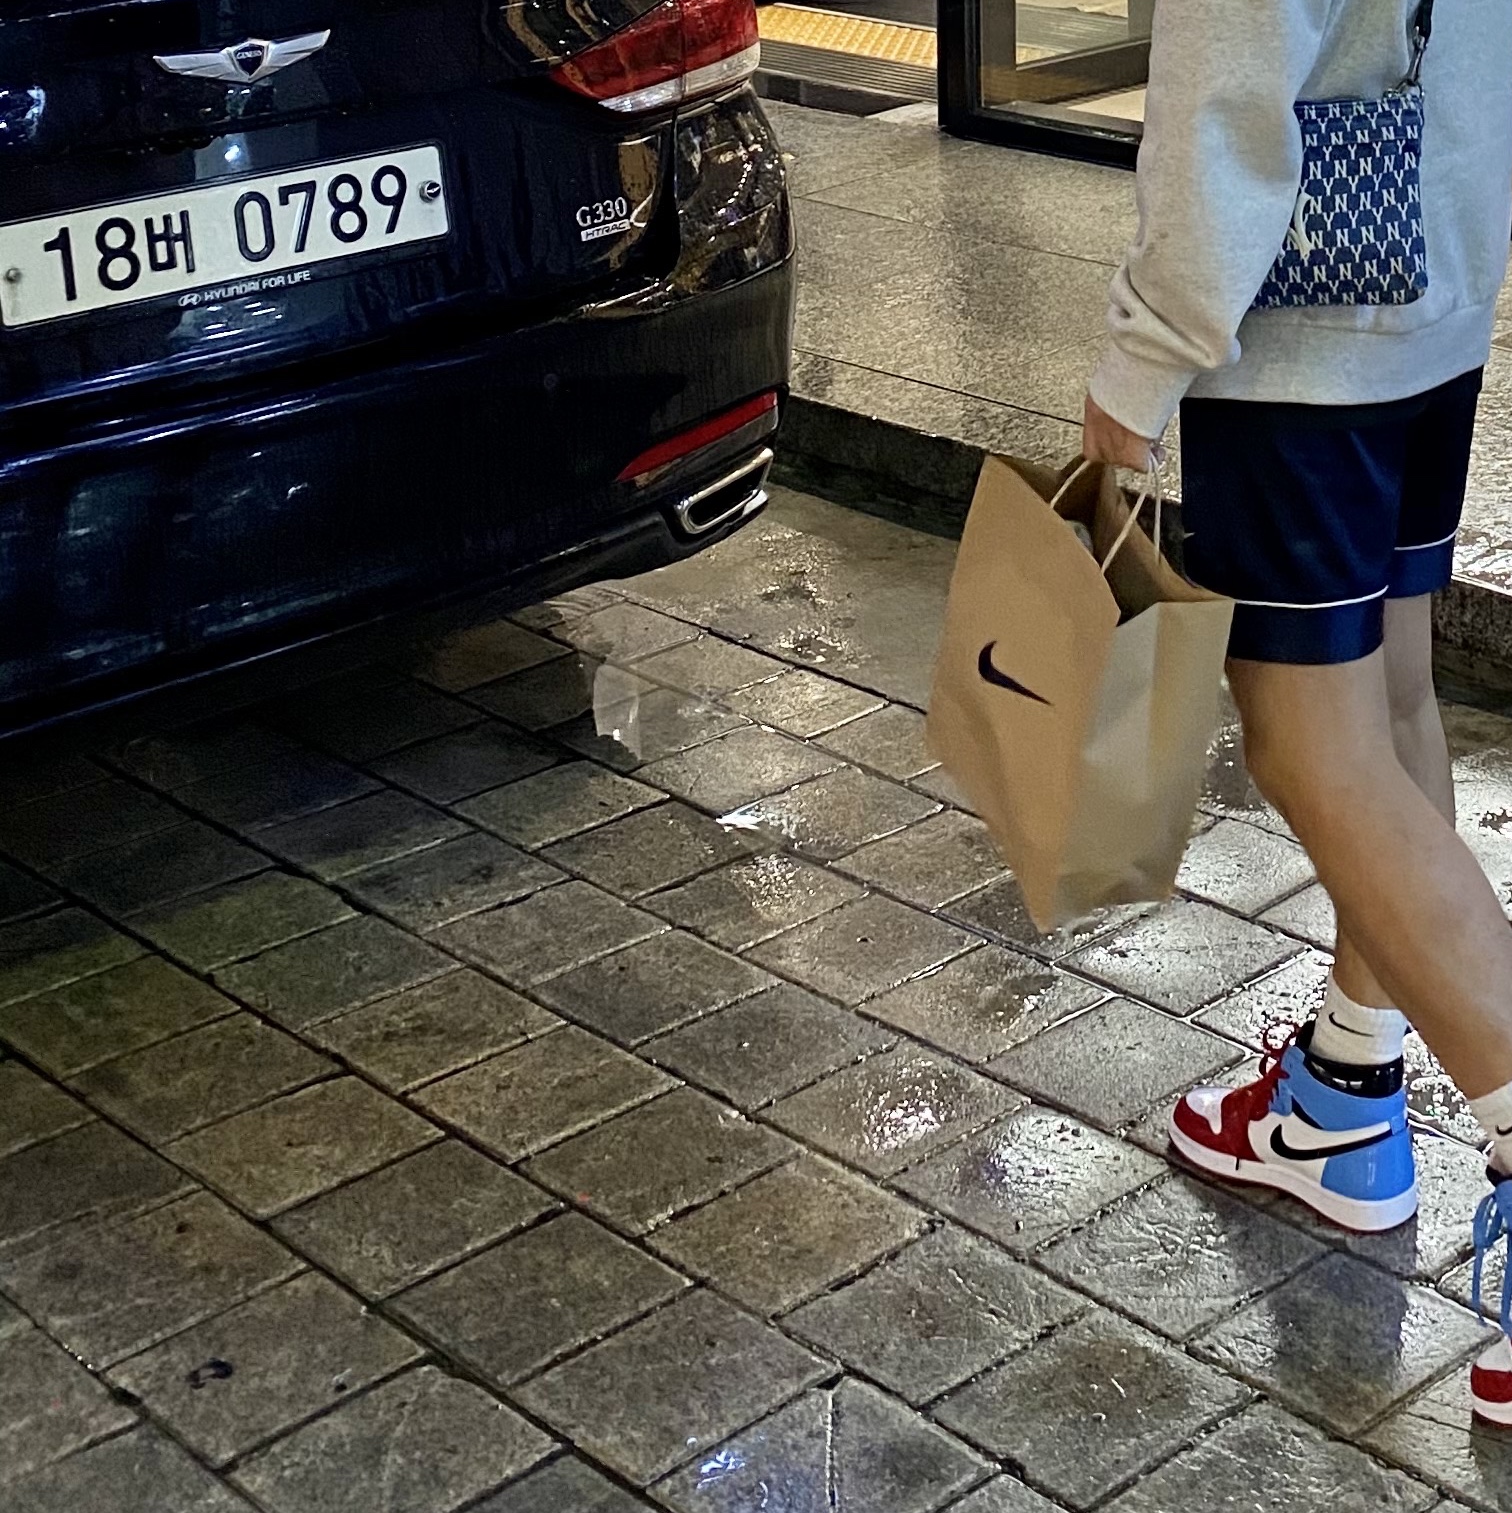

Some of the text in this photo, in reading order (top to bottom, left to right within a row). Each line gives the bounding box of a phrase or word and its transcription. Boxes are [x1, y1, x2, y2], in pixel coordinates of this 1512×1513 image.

[575, 196, 628, 228] G330
[43, 164, 408, 301] 18버 0789
[262, 275, 286, 290] FOR
[287, 269, 311, 285] LIFE
